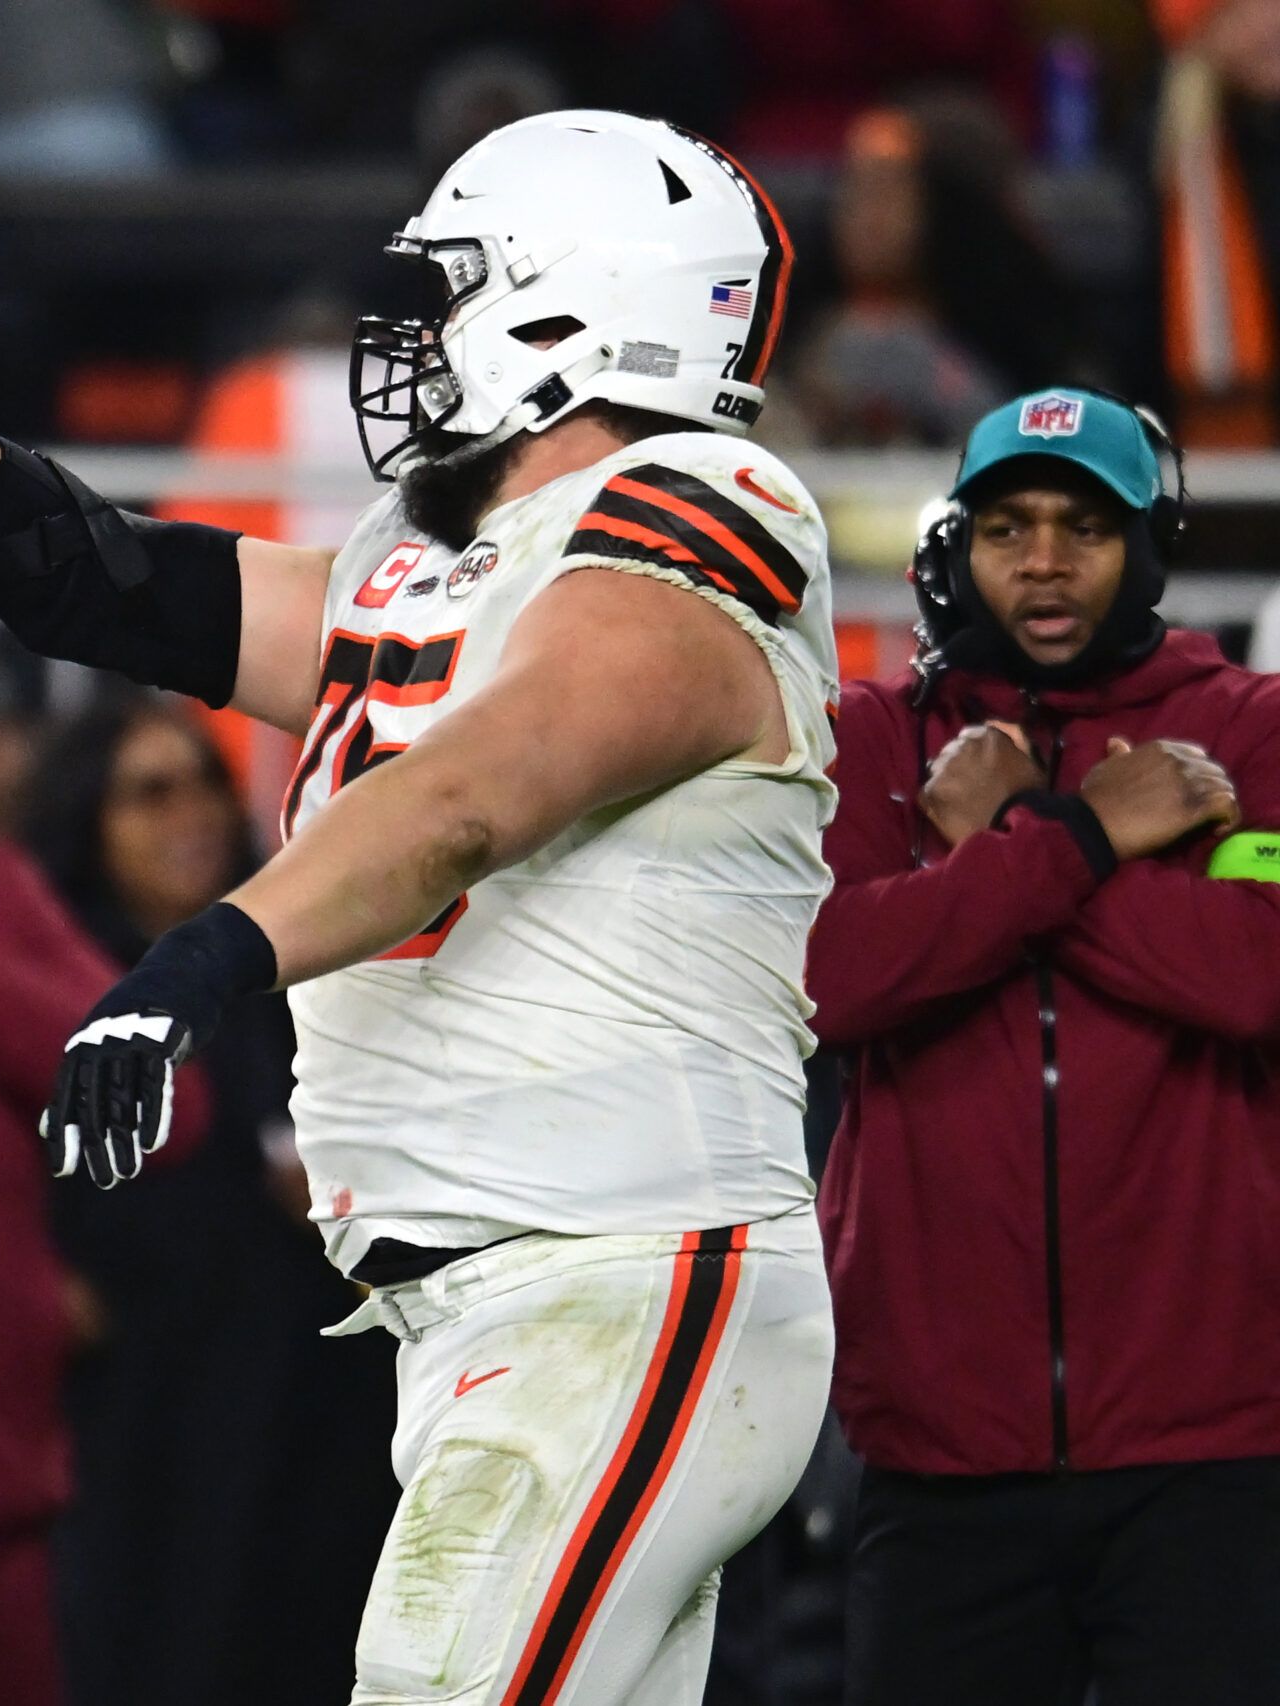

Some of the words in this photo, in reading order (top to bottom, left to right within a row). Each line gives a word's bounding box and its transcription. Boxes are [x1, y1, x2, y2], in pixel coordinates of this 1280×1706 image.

[720, 342, 743, 379] 7
[1026, 410, 1074, 433] NFL
[371, 547, 421, 591] C
